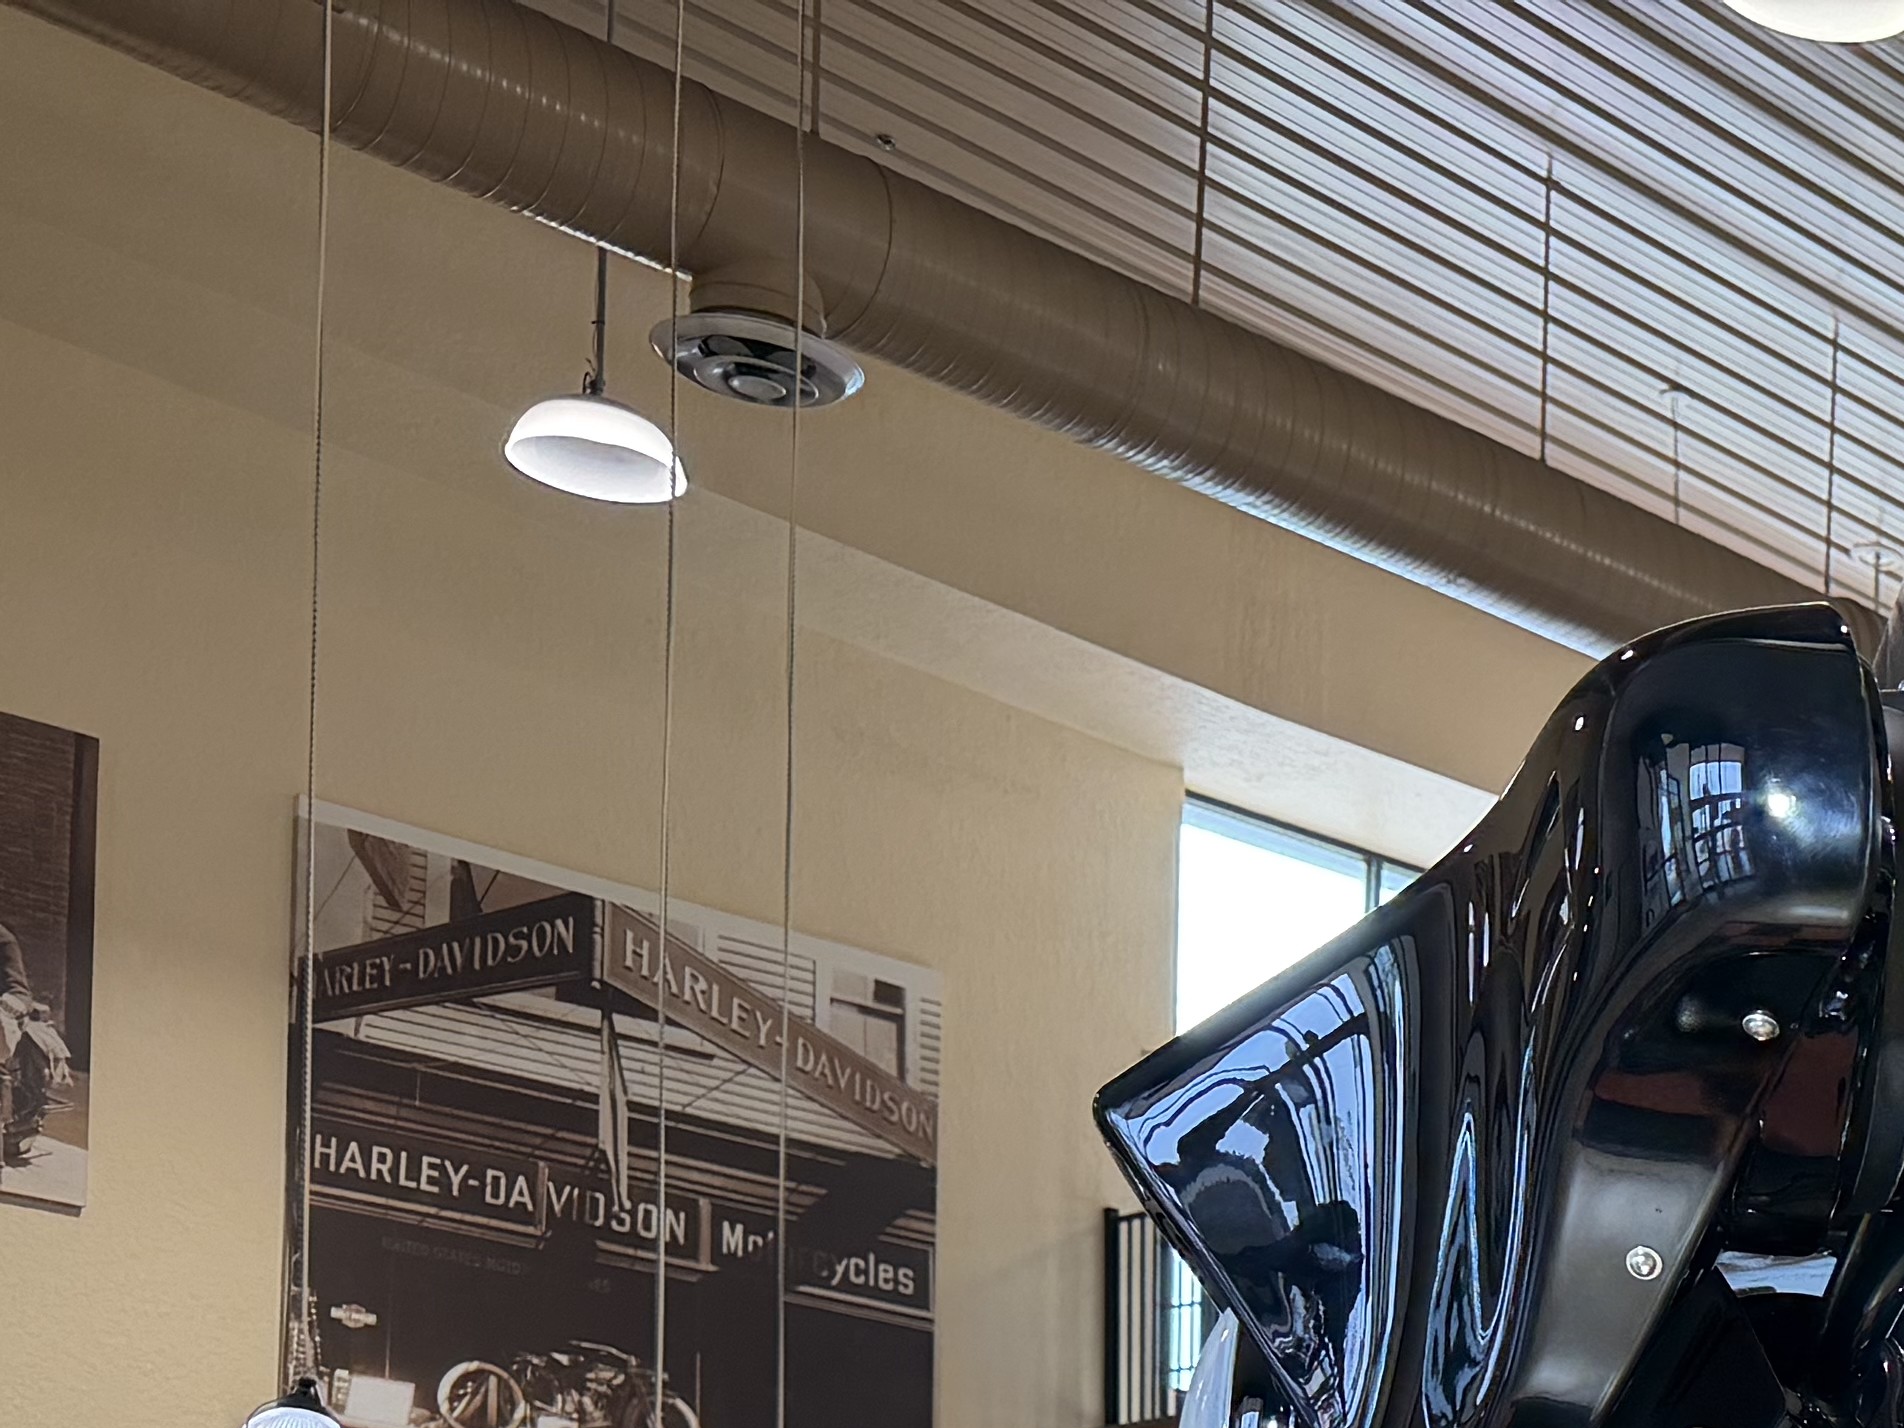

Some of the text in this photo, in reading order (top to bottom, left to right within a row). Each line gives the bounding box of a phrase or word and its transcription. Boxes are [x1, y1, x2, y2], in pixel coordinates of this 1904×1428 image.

[316, 916, 574, 998] ARLEY-DAVIDSON
[623, 927, 935, 1144] HARLEY-DAVIDSON
[315, 1133, 916, 1297] HARLEY-DAVIDSON Mocycles
